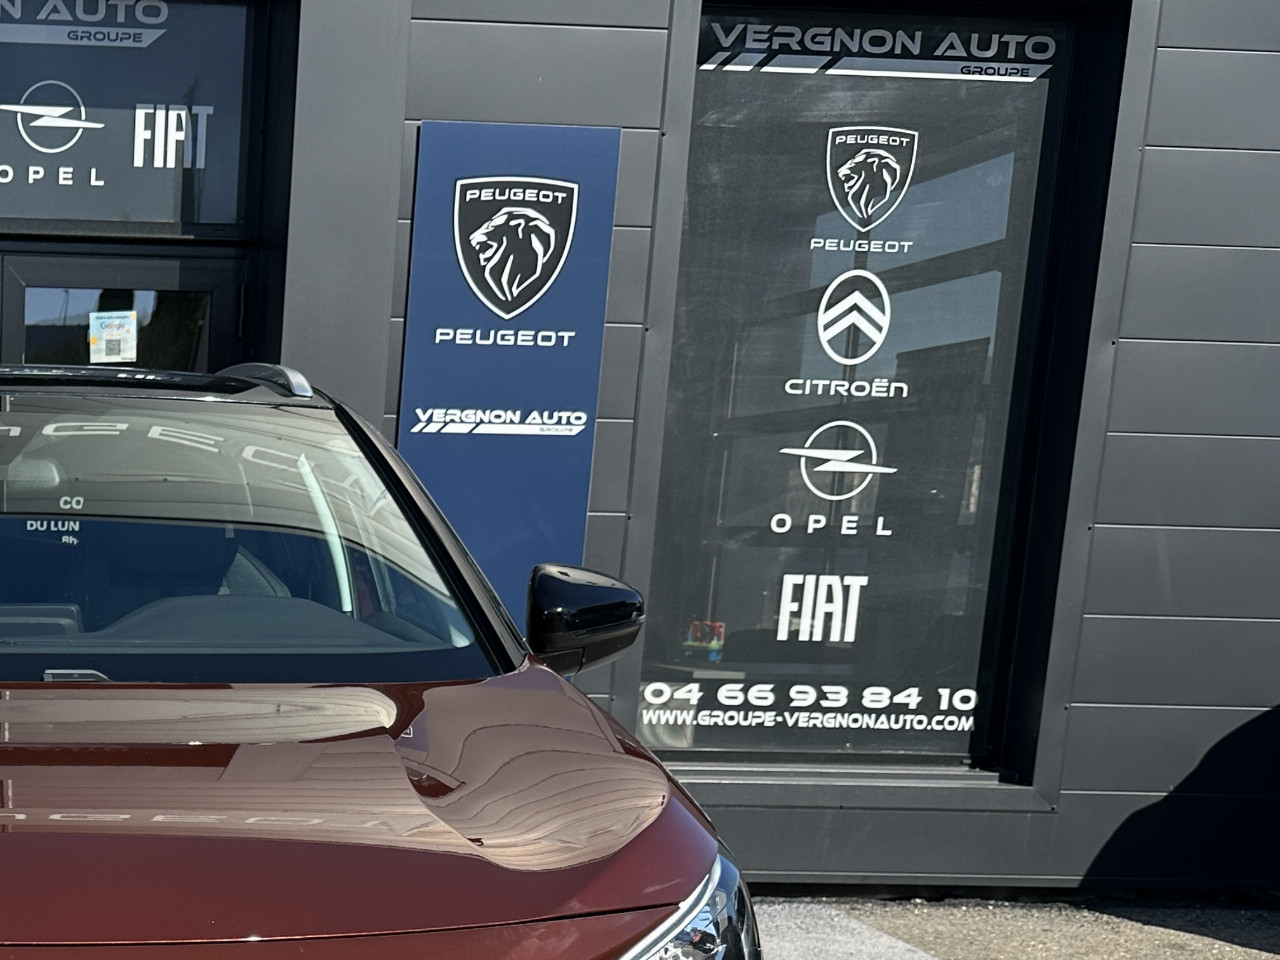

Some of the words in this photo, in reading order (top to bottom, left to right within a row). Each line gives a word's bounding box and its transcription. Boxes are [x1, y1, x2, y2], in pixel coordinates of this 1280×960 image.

[36, 0, 169, 25] AUTO
[66, 30, 144, 43] GROUPE
[710, 22, 922, 56] VERGNON
[933, 32, 1056, 61] AUTO
[960, 65, 1031, 77] GROUPE
[133, 103, 214, 168] FIAT
[835, 134, 911, 147] PEUGEOT
[466, 188, 567, 204] PEUGEOT
[810, 238, 913, 253] PEUGEOT
[435, 328, 576, 346] PEUGEOT
[415, 408, 521, 424] VERGNON
[524, 410, 588, 425] AUTO
[26, 520, 48, 531] DU
[50, 520, 80, 532] LUN
[770, 513, 893, 535] OPEL
[776, 574, 869, 642] FIAT
[643, 682, 704, 705] 04
[717, 683, 775, 706] 66
[788, 685, 848, 708] 93
[861, 686, 923, 709] 84
[937, 688, 978, 710] 10
[641, 709, 975, 731] WWW.GROUPE-VERGNONAUTO.COM
